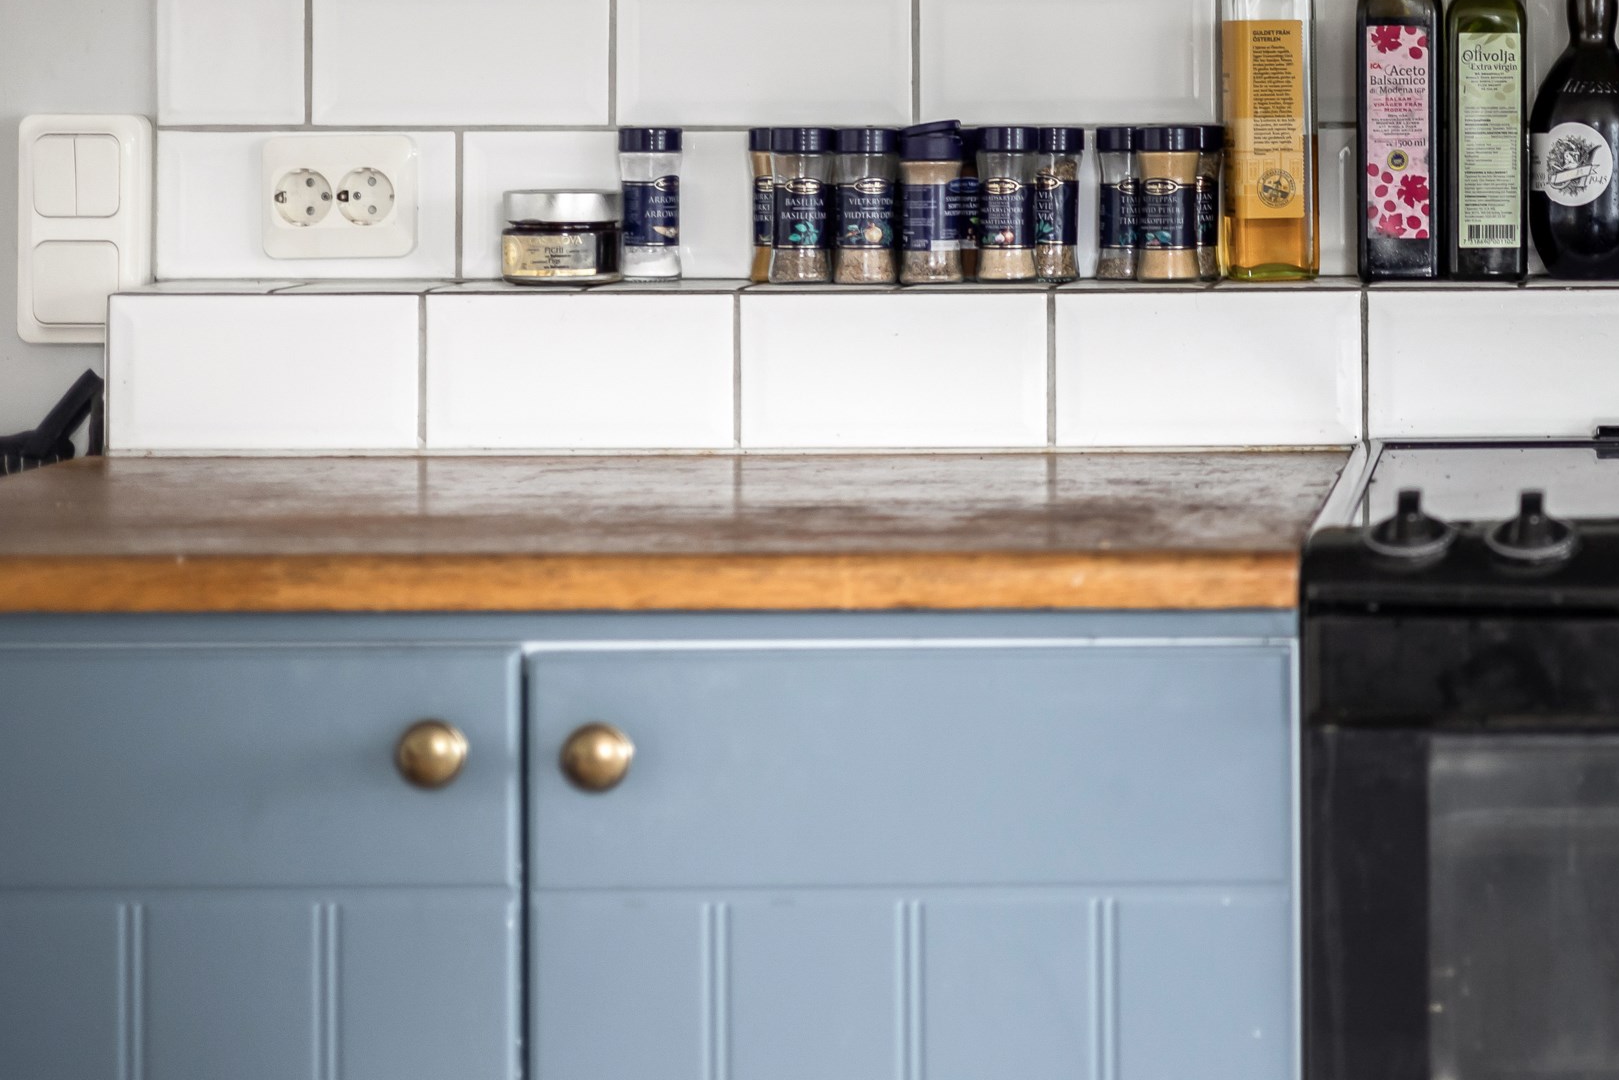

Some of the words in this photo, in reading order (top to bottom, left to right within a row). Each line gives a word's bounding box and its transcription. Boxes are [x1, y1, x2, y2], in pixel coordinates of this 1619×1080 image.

[1462, 44, 1516, 64] Olivolja
[1389, 65, 1426, 77] Aceto
[1470, 63, 1492, 71] Extra
[1494, 63, 1518, 73] virgin
[1370, 75, 1426, 86] Balsamico
[1380, 86, 1413, 94] Modena
[1414, 137, 1426, 147] ml
[785, 198, 824, 207] BASILIKA
[781, 211, 827, 220] BASILIKUM
